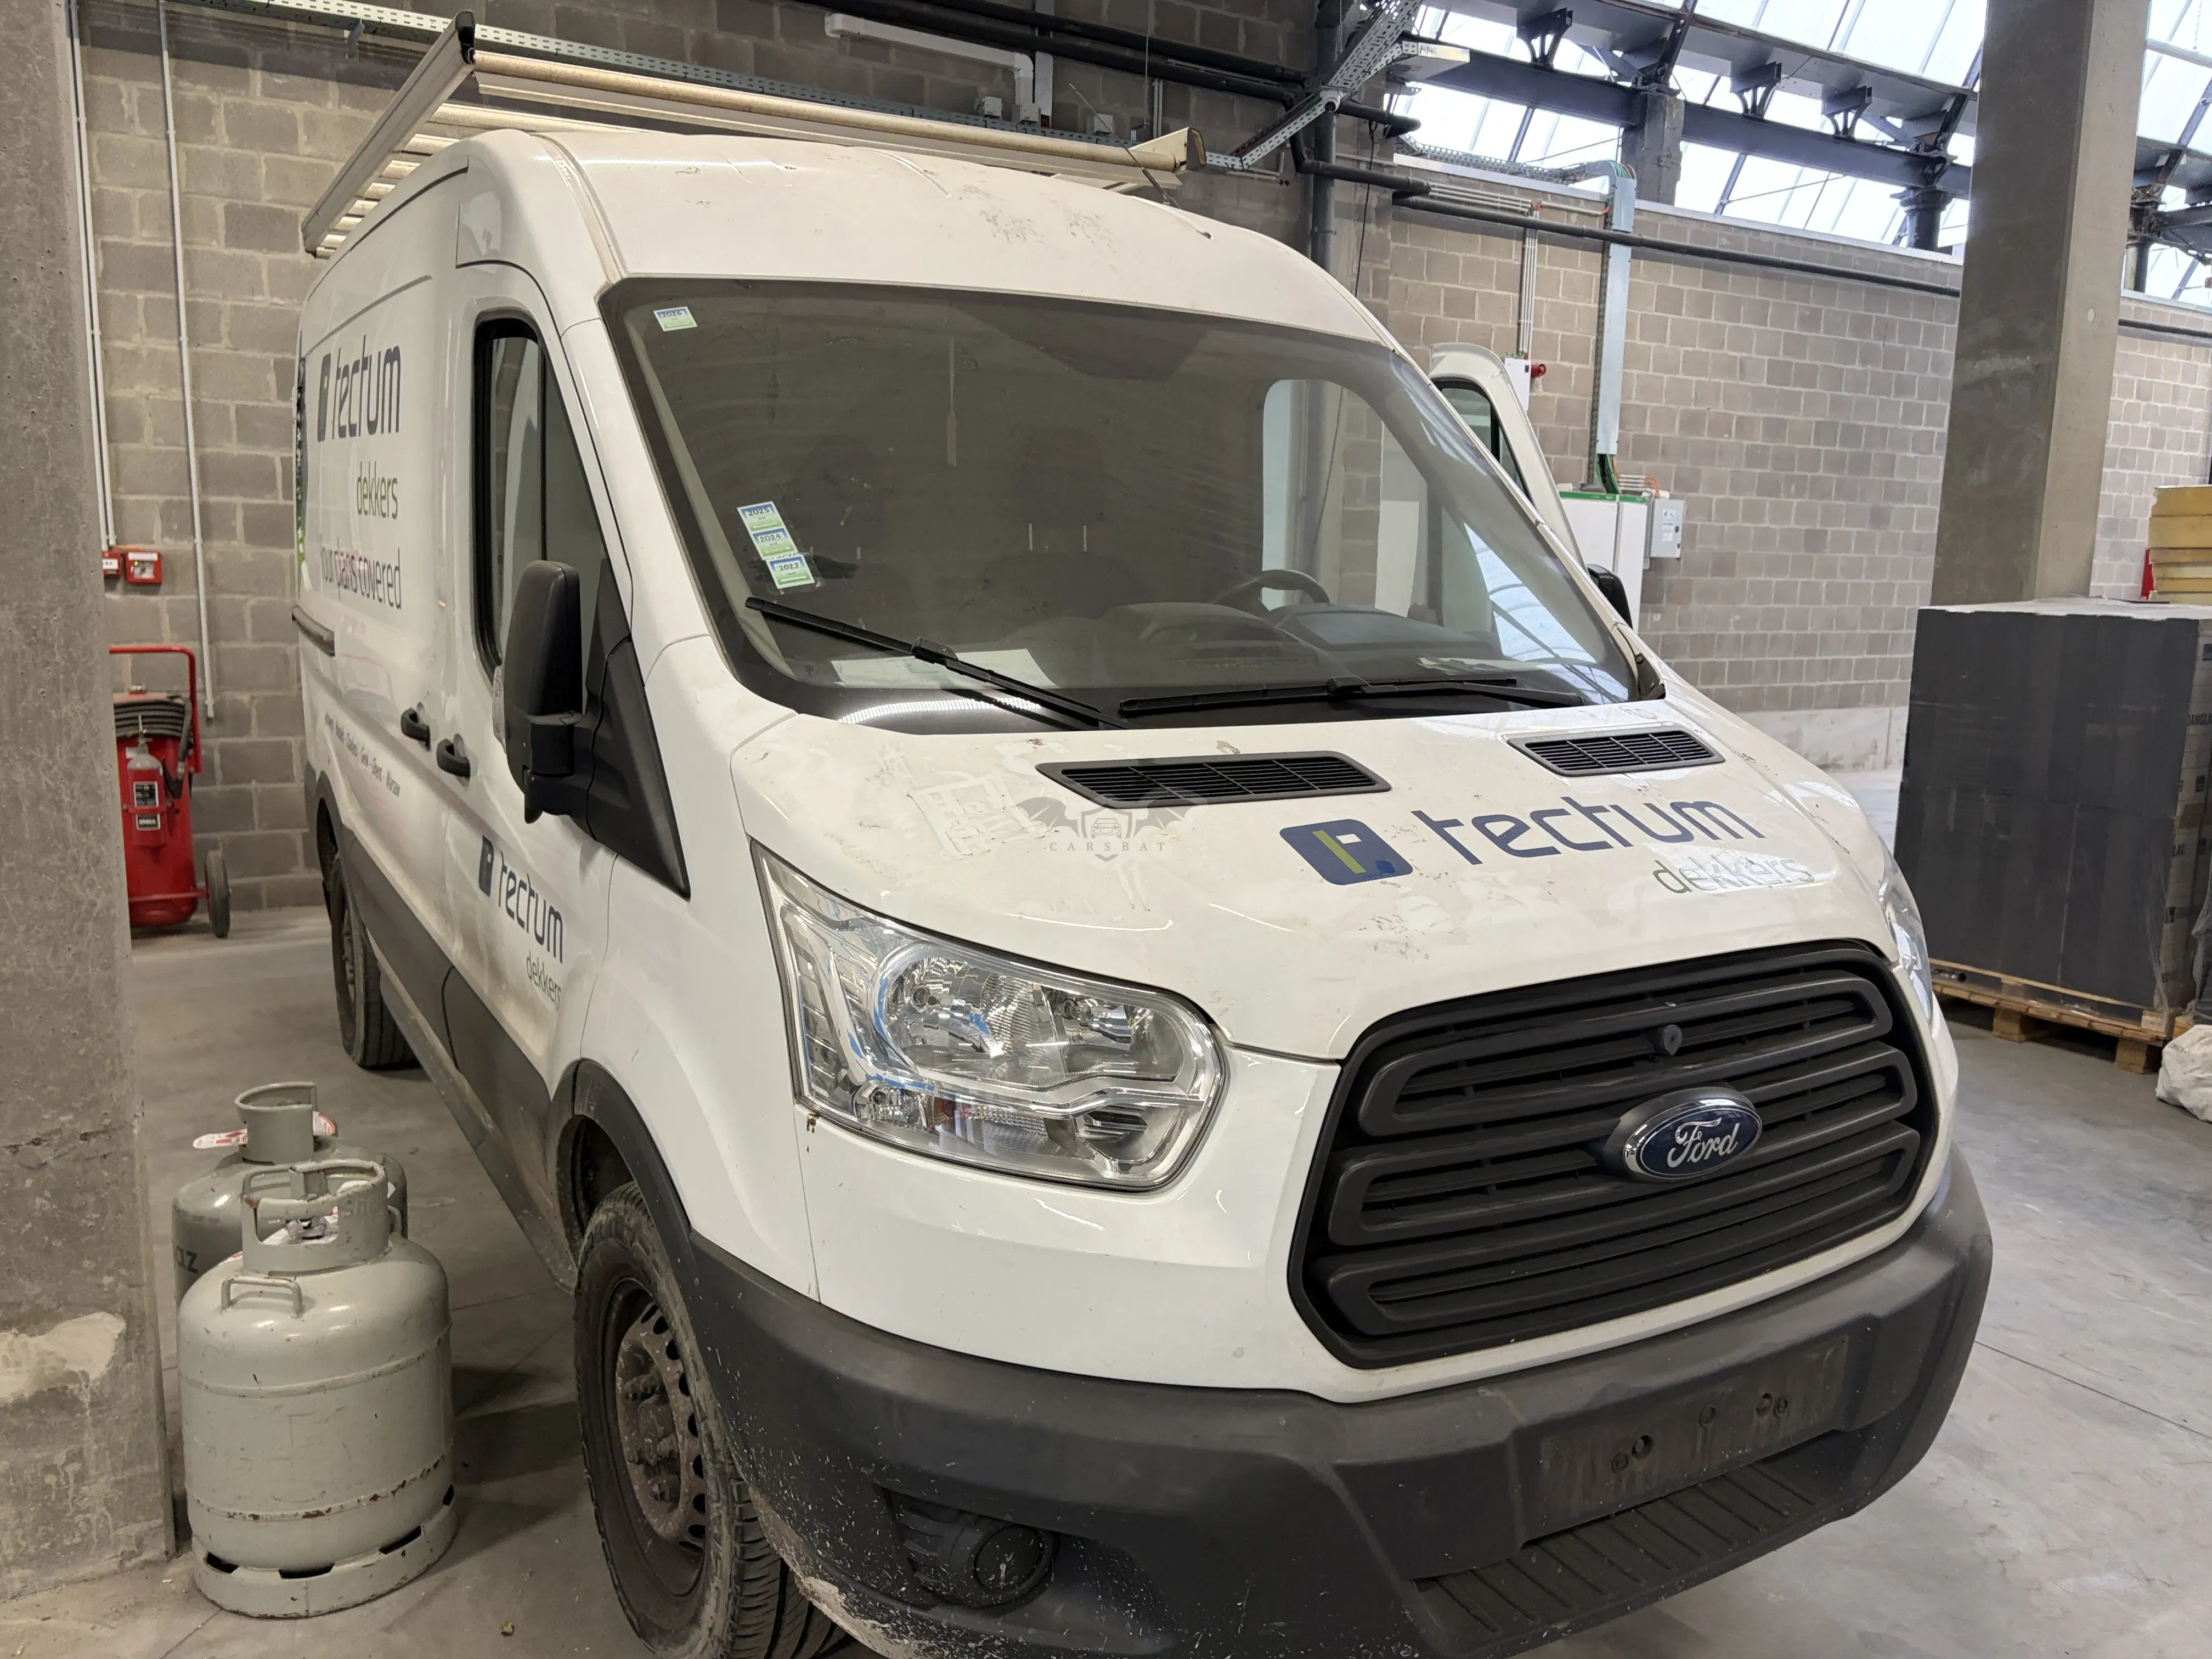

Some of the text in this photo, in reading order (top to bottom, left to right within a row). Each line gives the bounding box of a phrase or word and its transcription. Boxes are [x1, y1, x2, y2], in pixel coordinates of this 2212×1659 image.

[332, 335, 401, 439] tectum
[356, 461, 398, 520] dekkers
[747, 507, 770, 516] 2025
[759, 533, 781, 543] 2024
[778, 562, 799, 571] 2023
[358, 548, 402, 610] covered
[1410, 796, 1766, 865] tectum
[1652, 859, 1816, 895] dekkers
[498, 851, 564, 964] tectum
[527, 949, 562, 1011] dekkers
[1667, 1117, 1740, 1169] Ford
